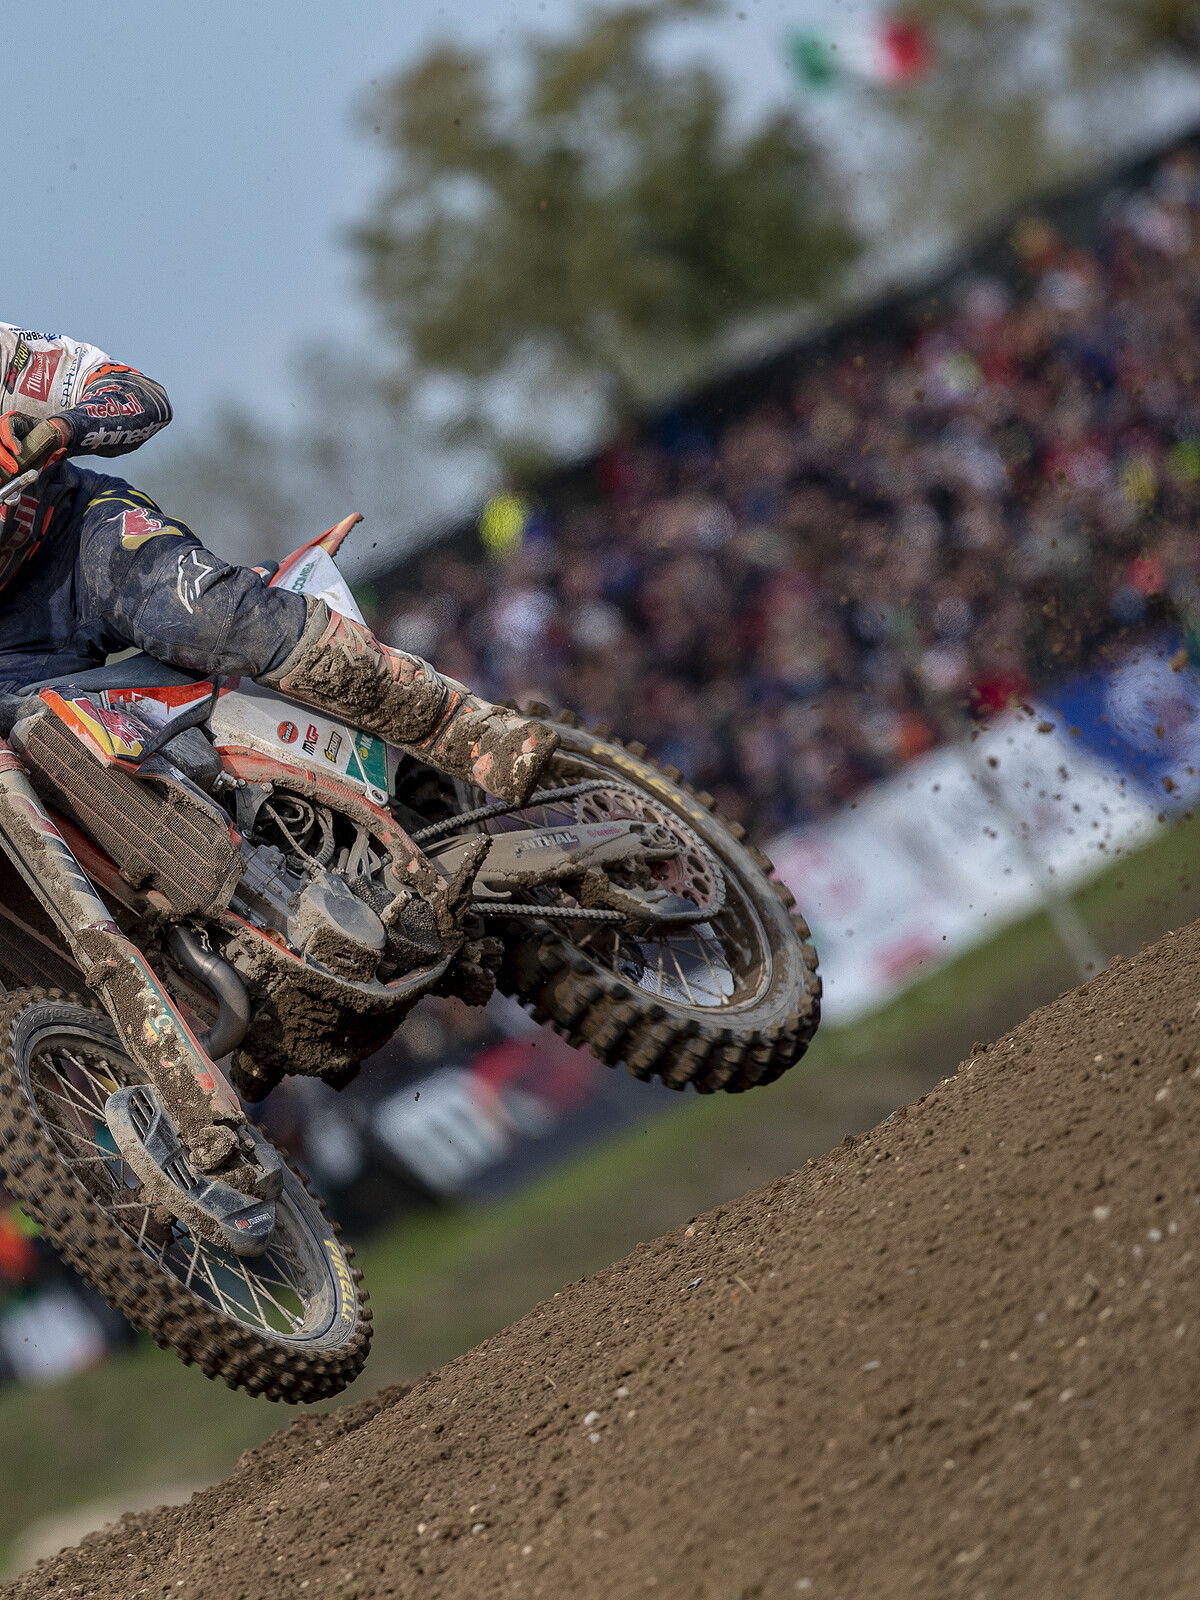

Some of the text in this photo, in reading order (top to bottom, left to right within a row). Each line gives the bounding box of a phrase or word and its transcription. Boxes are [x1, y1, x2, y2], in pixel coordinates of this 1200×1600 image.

[80, 397, 120, 418] Red
[302, 723, 319, 756] MXGP
[513, 832, 579, 852] ENTHAL
[323, 1239, 354, 1322] PIRELLI
